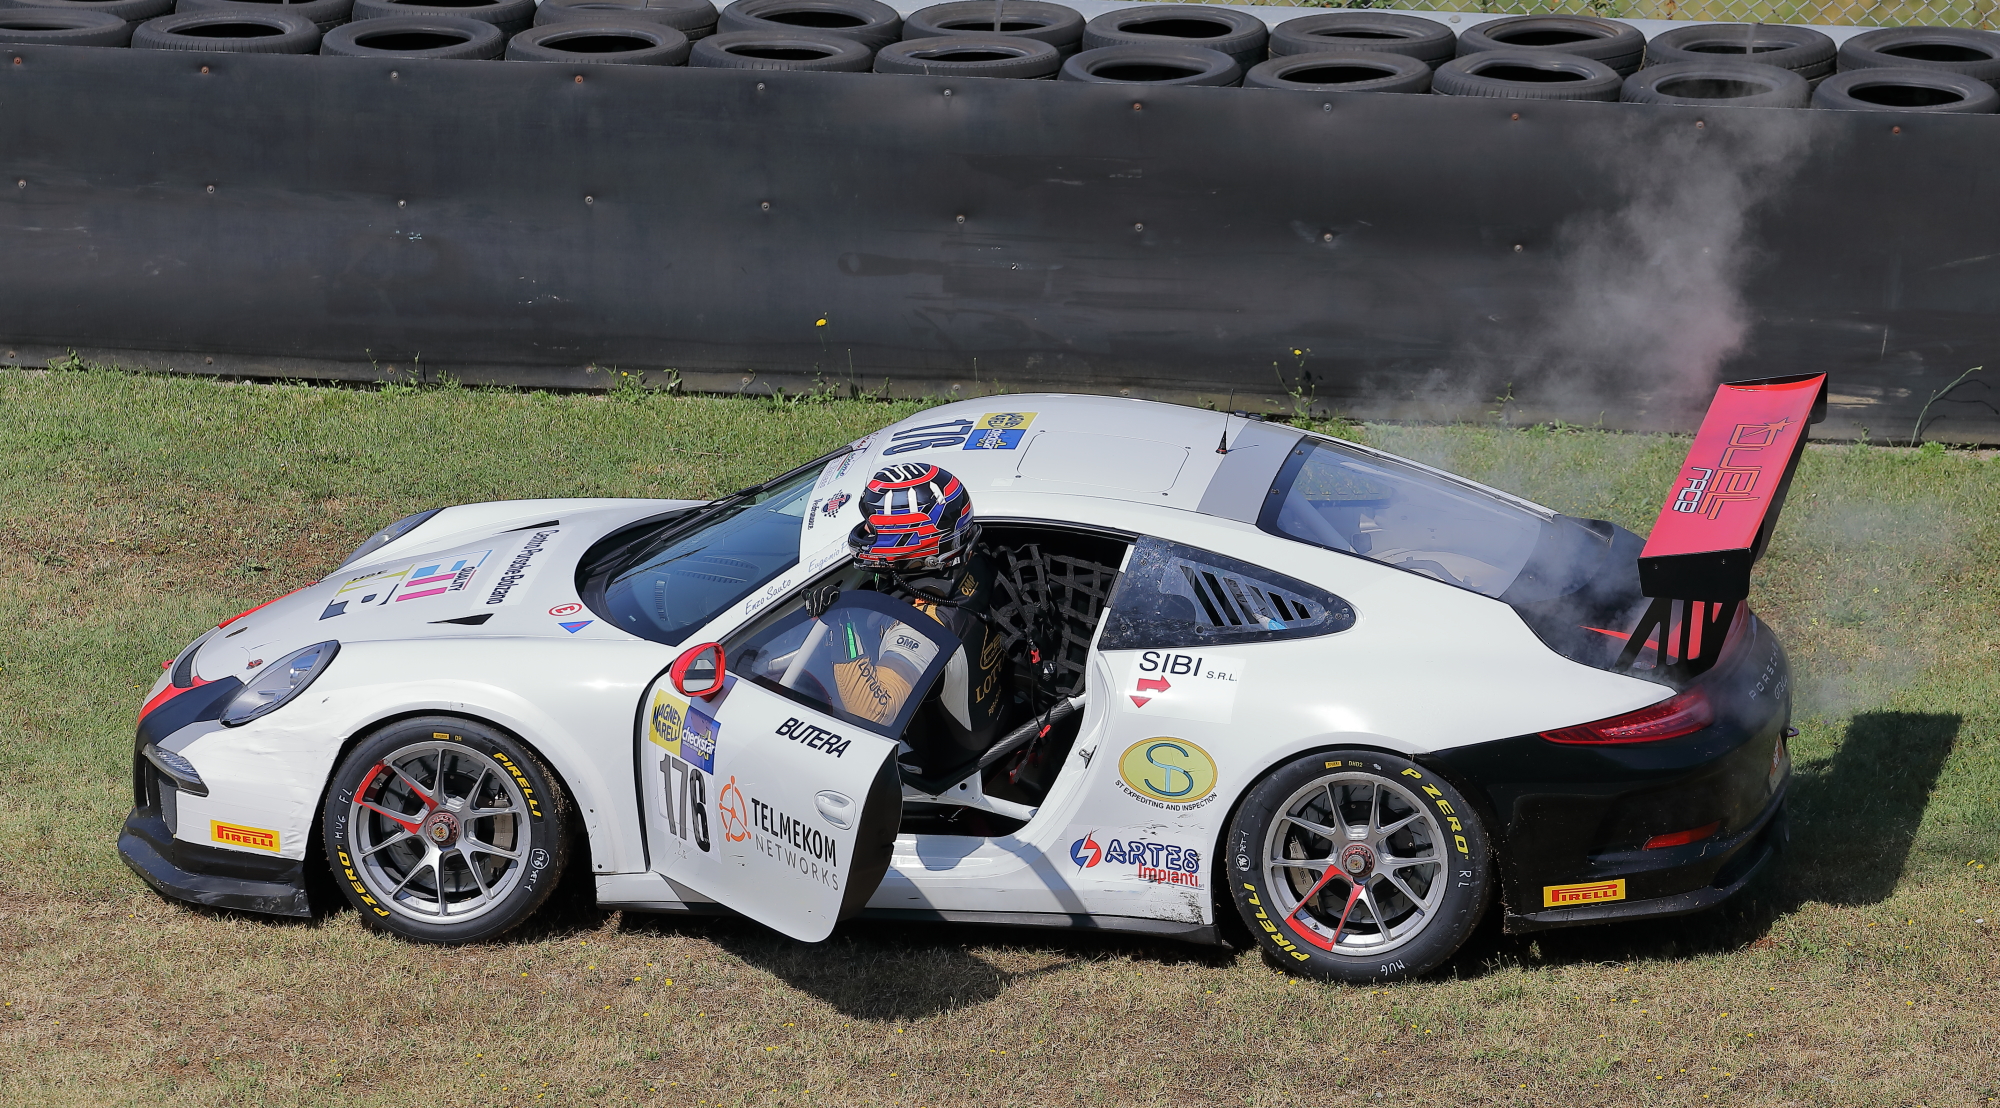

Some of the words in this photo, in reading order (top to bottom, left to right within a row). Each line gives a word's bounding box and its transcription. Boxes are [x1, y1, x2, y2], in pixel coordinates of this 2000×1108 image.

[883, 419, 974, 456] 176
[504, 548, 544, 575] Porsche
[448, 566, 475, 591] QUALITY
[486, 574, 525, 605] Bolzano
[745, 598, 765, 616] Enzo
[808, 549, 840, 573] Eugenio
[896, 636, 920, 650] OMP
[1139, 651, 1203, 677] SIBI
[1206, 671, 1238, 682] S.R.L.
[682, 727, 715, 755] checkstar
[775, 717, 852, 758] BUTERA
[493, 752, 542, 818] PIRELLI
[1115, 779, 1125, 789] ST
[1123, 787, 1164, 809] EXPEDITING
[1165, 803, 1181, 811] AND
[1182, 791, 1218, 811] INSPECTION
[660, 753, 711, 852] 176
[216, 825, 274, 847] PIRELLI
[751, 797, 837, 867] TELMEKOM
[755, 834, 840, 891] NETWORKS
[1104, 839, 1200, 874] ARTES
[1138, 862, 1199, 887] Impianti
[1551, 884, 1618, 903] PIRELLI
[1243, 882, 1311, 962] PIRELLI
